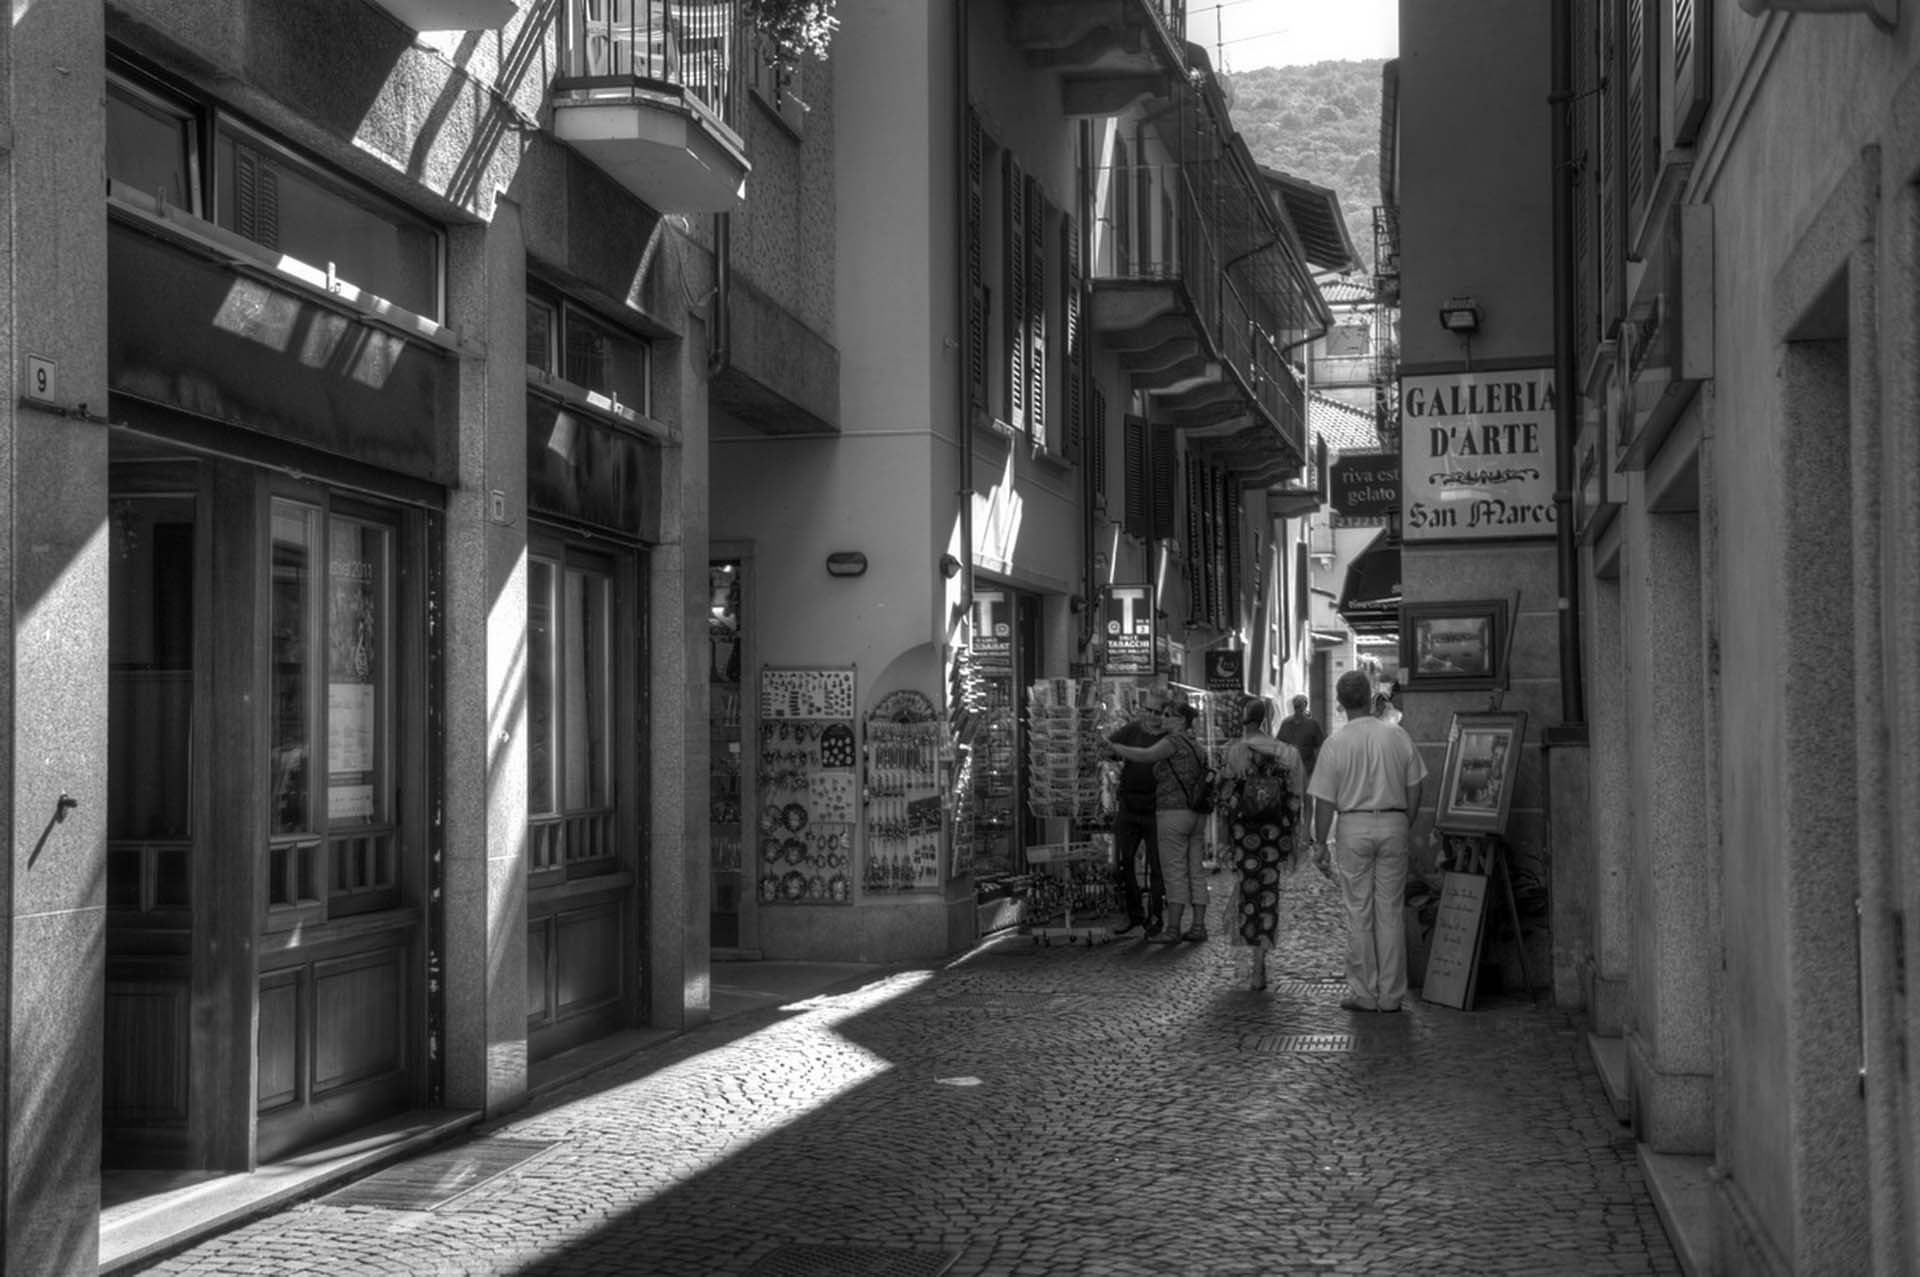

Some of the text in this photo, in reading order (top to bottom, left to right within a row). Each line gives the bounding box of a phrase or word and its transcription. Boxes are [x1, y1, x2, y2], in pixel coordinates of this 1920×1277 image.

[37, 368, 46, 392] 9
[1406, 380, 1557, 418] GALLERIA
[1430, 423, 1539, 458] D'ARTE
[1342, 467, 1373, 483] riva
[1347, 486, 1396, 506] gelato
[1408, 502, 1457, 528] San
[1466, 499, 1558, 527] Marco
[1111, 588, 1144, 634] T
